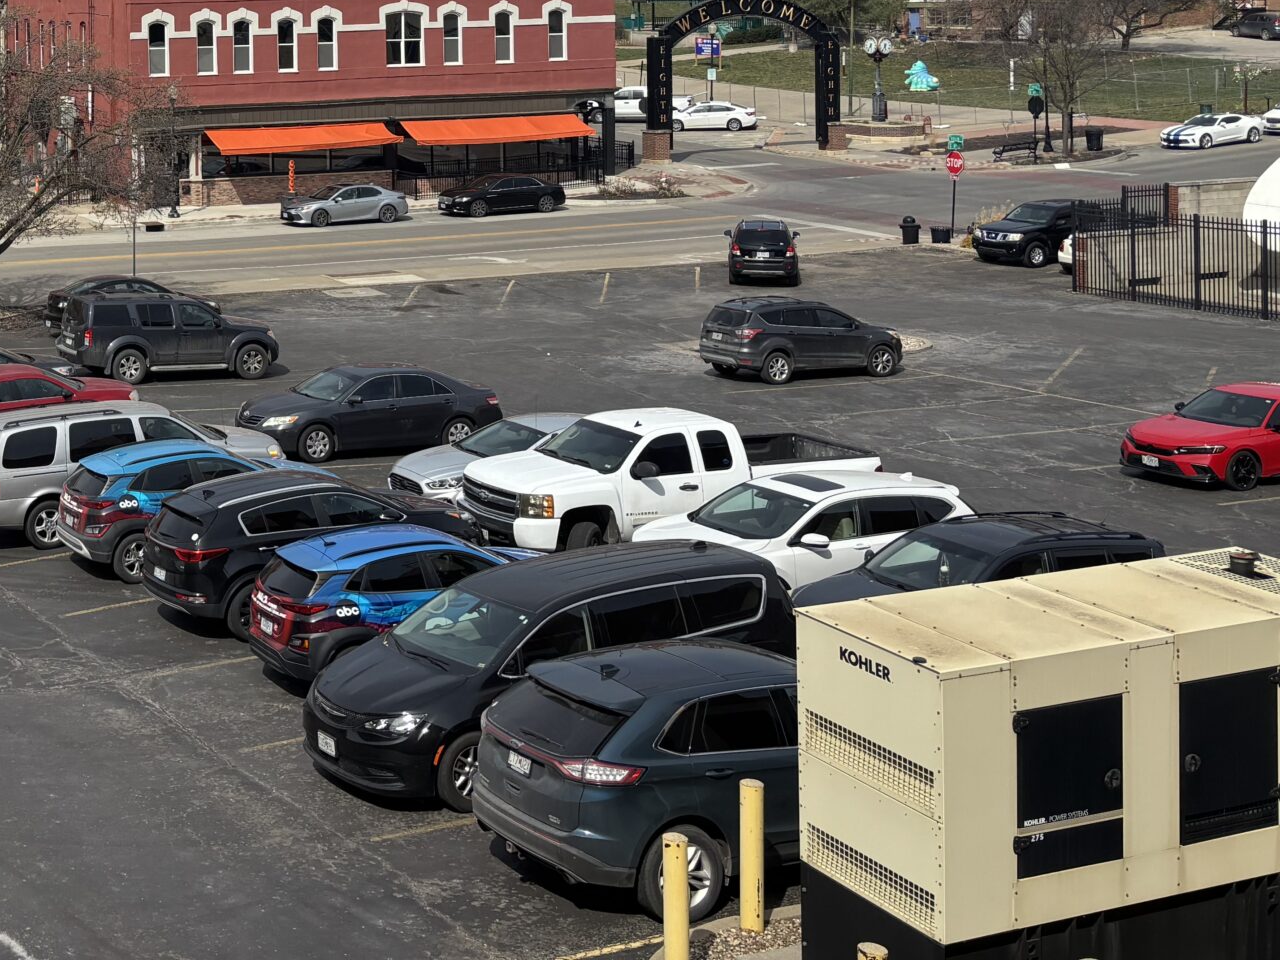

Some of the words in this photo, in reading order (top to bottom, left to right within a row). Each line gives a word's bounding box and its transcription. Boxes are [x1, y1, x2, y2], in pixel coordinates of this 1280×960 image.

[659, 45, 667, 123] EIGHTH
[827, 40, 835, 116] EIGHTH
[946, 157, 963, 168] STOP
[118, 498, 139, 509] abc
[335, 605, 360, 617] abc
[1048, 813, 1068, 823] POWER
[1068, 808, 1089, 820] SYSTEMS
[1030, 833, 1045, 843] 275
